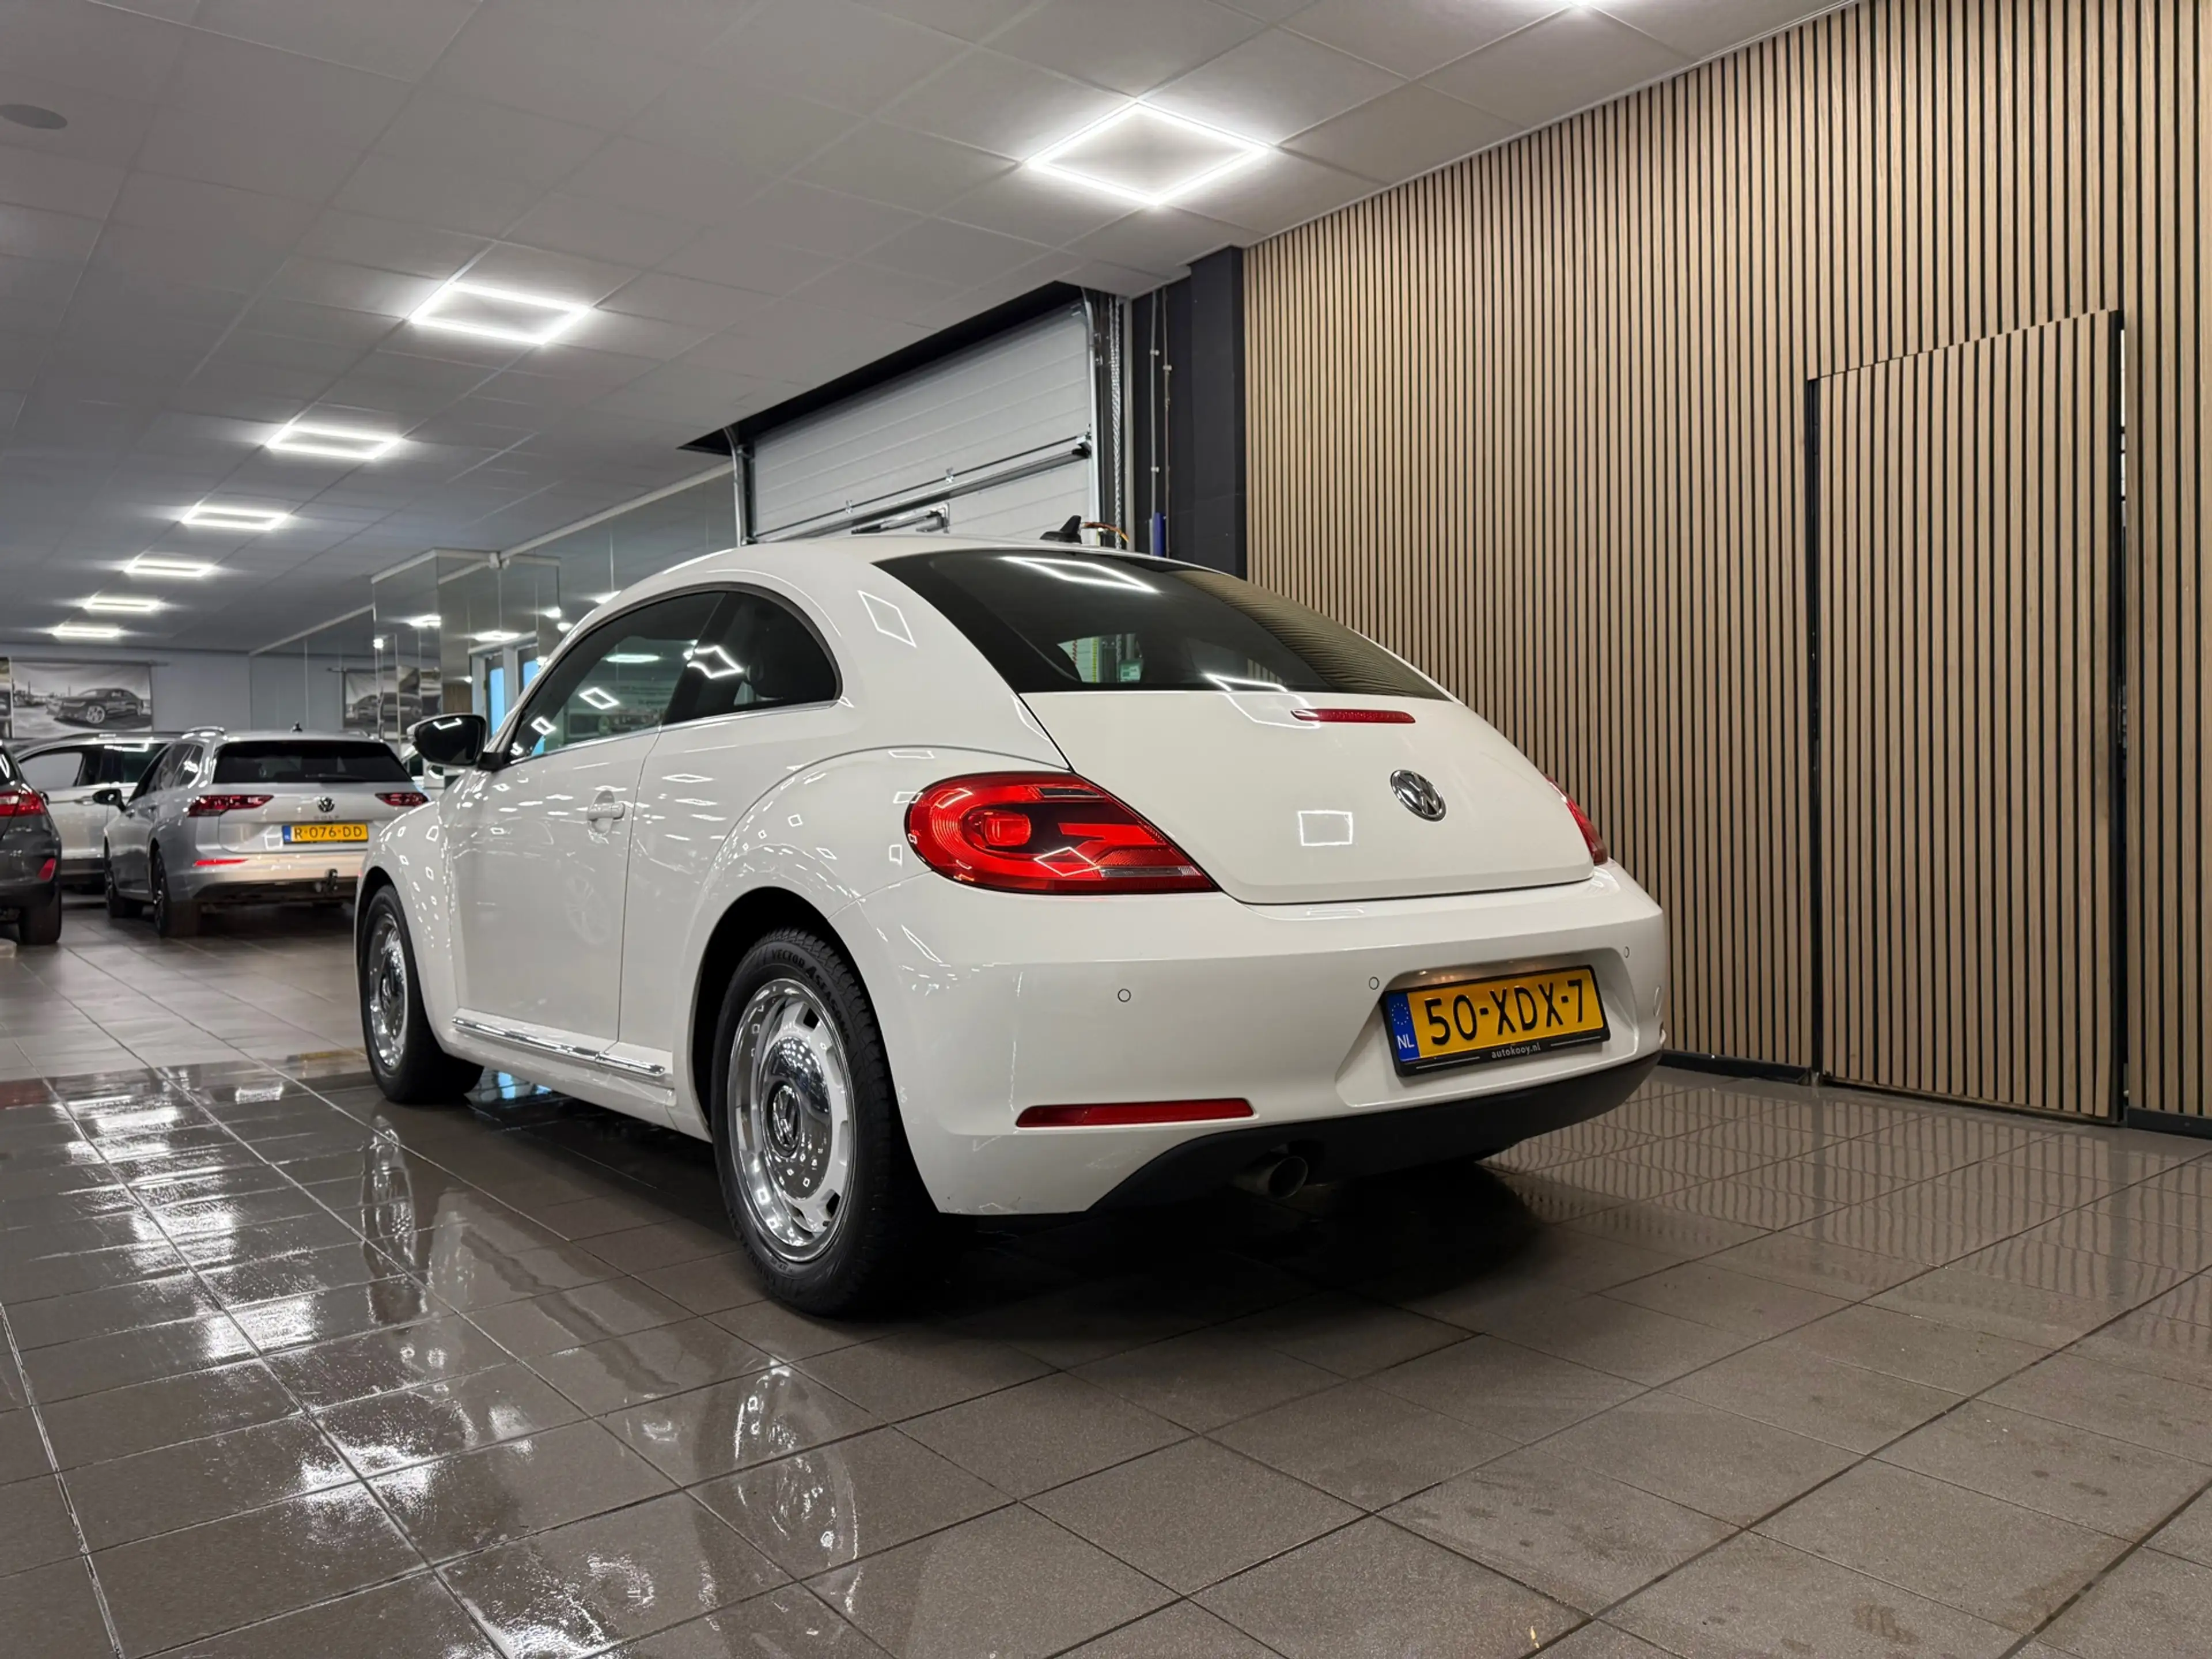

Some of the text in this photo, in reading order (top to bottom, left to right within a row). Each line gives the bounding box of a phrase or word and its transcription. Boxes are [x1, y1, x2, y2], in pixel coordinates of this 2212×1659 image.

[771, 949, 805, 968] VECTOR
[1424, 979, 1584, 1046] 50-XDX-7
[1396, 1033, 1415, 1050] NL
[1491, 1042, 1541, 1059] autokooy.nl
